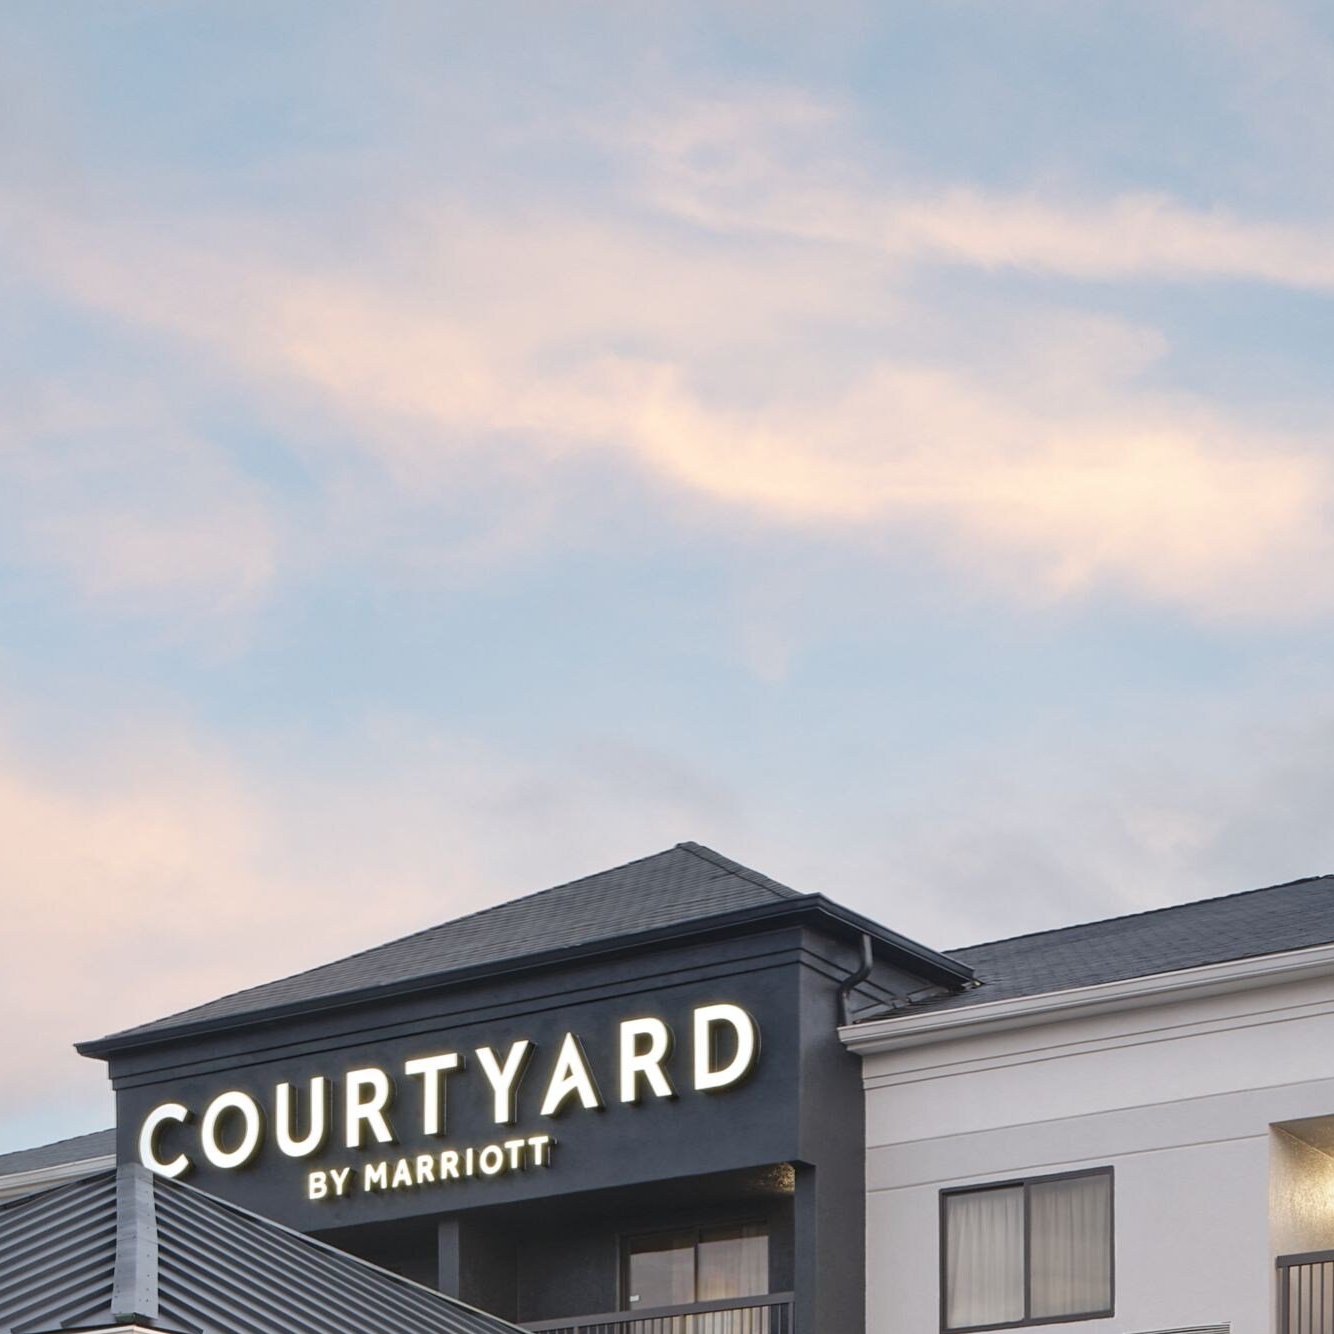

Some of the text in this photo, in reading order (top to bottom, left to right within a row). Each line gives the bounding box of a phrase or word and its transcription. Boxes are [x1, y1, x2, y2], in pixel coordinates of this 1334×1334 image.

[139, 1004, 756, 1178] COURTYARD
[308, 1136, 550, 1199] BY MARRIOTT
